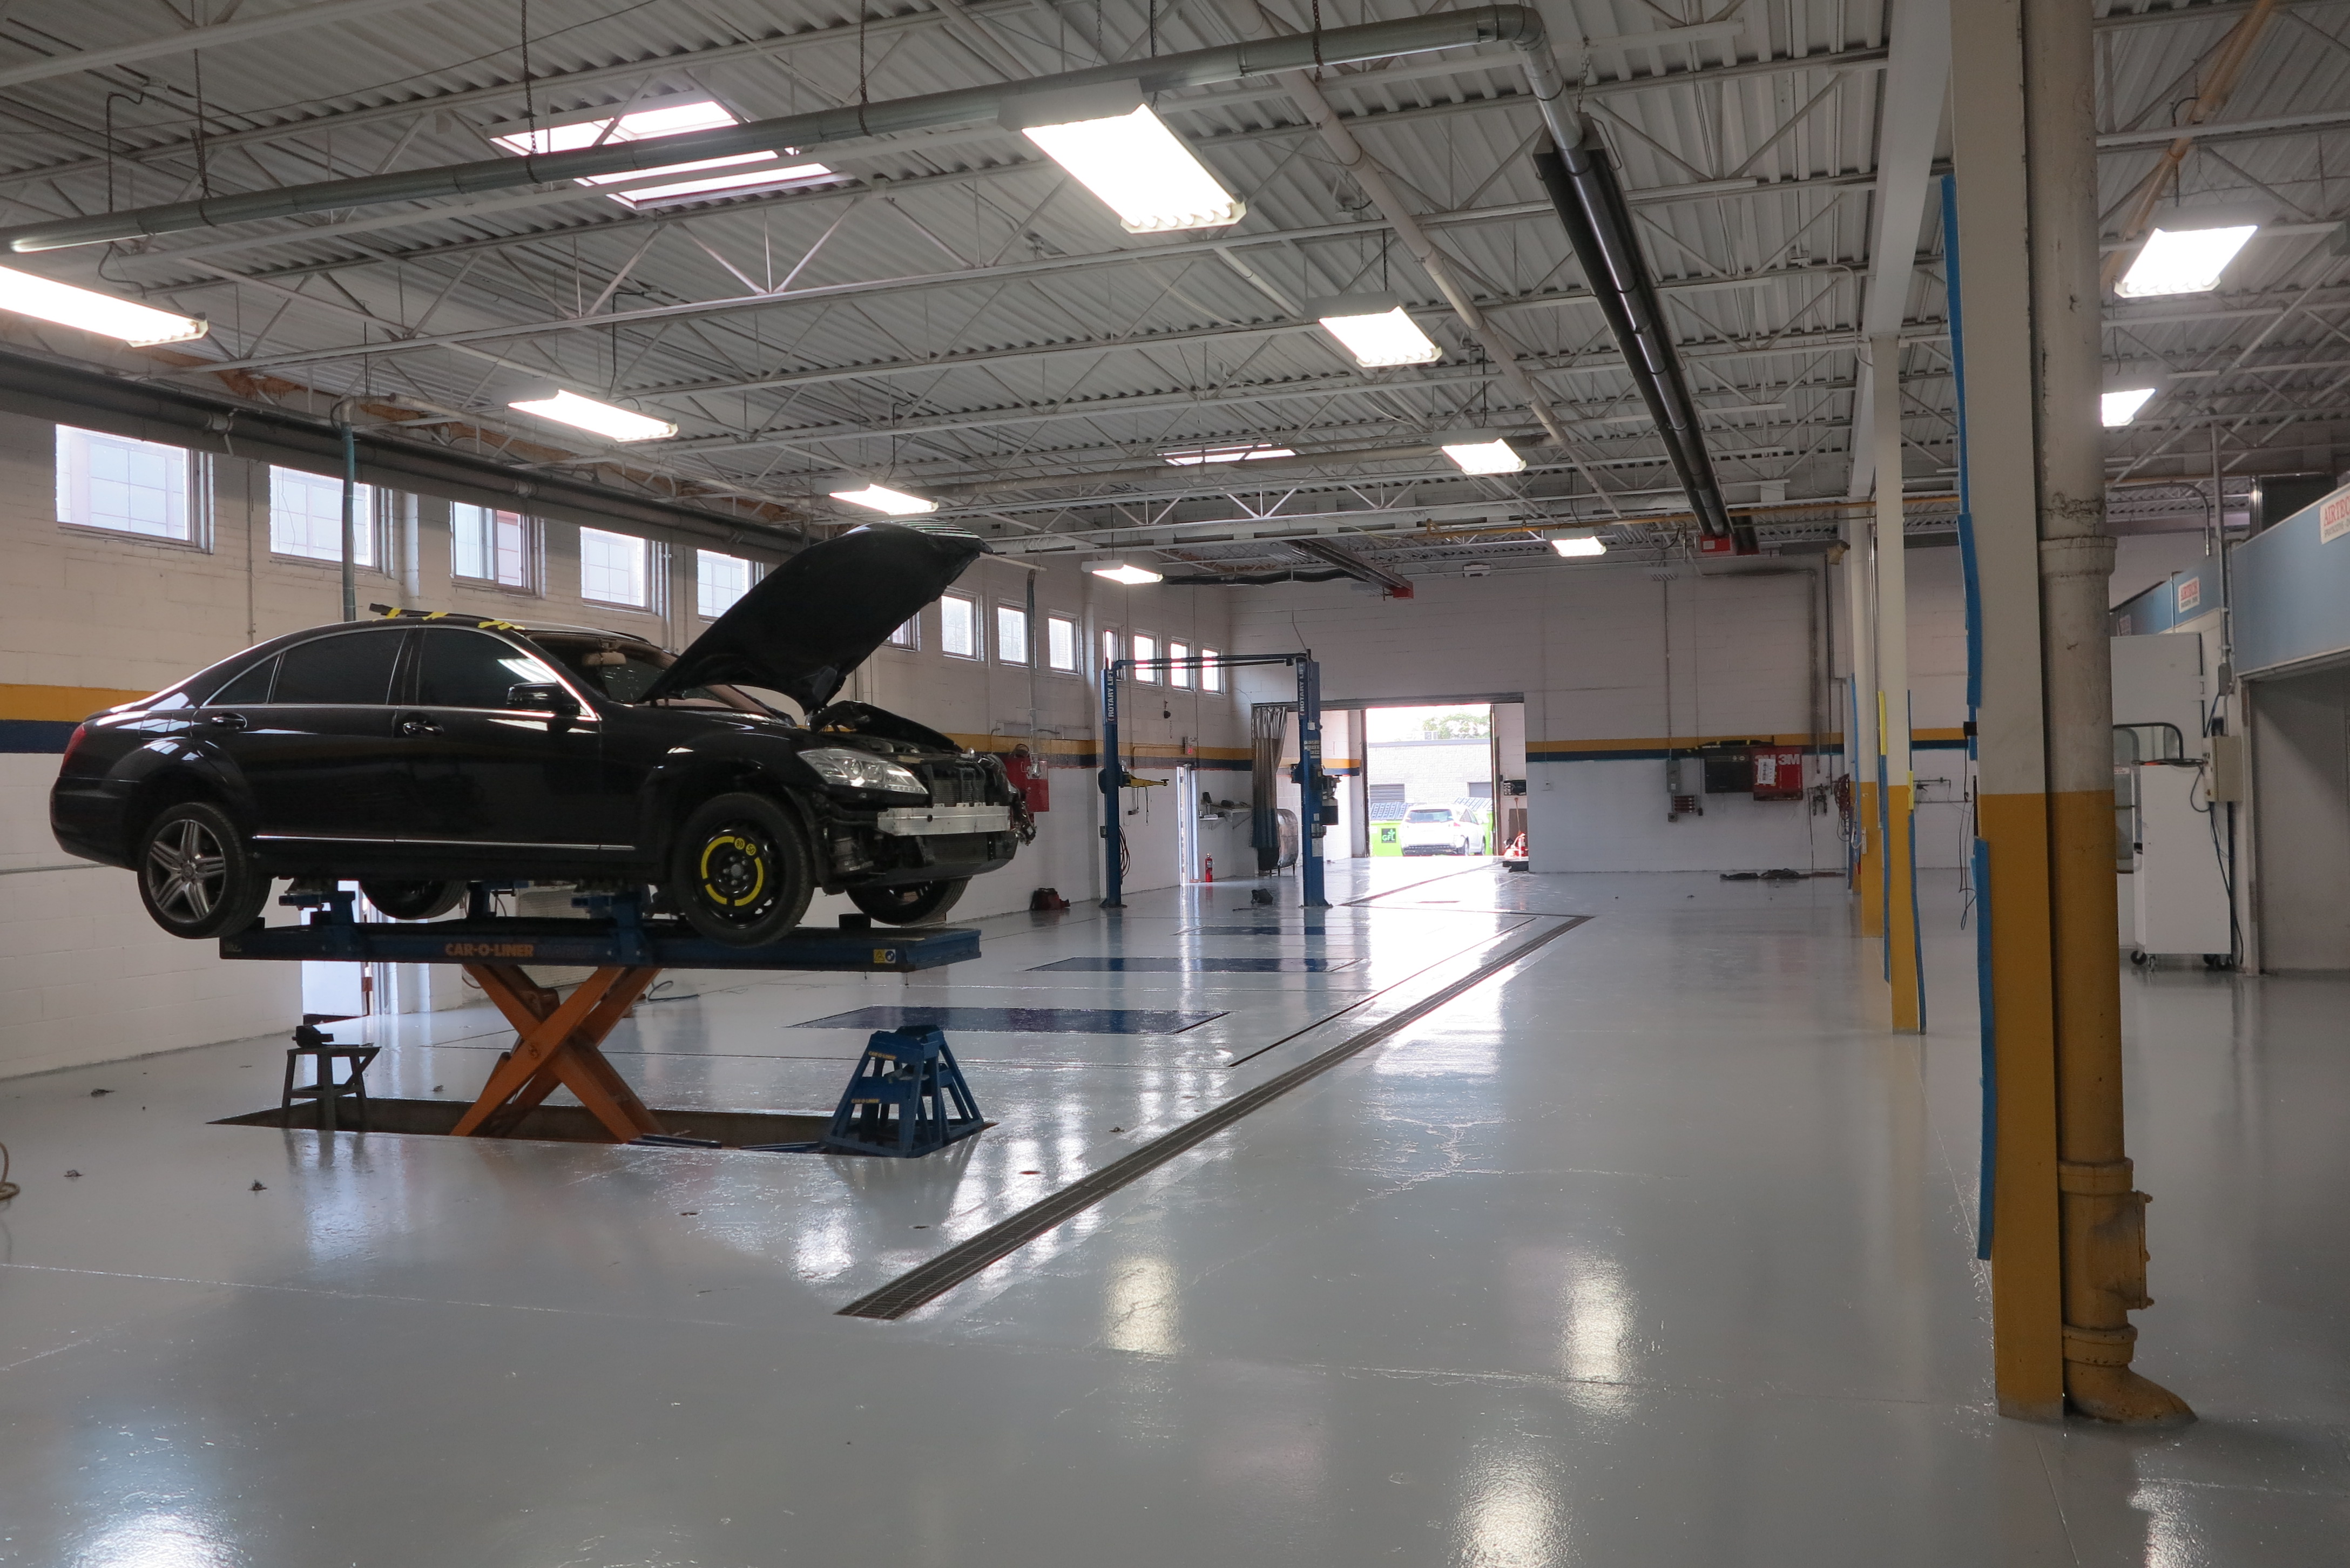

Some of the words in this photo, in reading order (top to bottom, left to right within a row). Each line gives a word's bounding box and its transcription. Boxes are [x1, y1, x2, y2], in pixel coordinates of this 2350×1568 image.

[1778, 754, 1800, 765] 3M
[746, 844, 755, 854] 50
[445, 943, 534, 956] CAR-O-LINER
